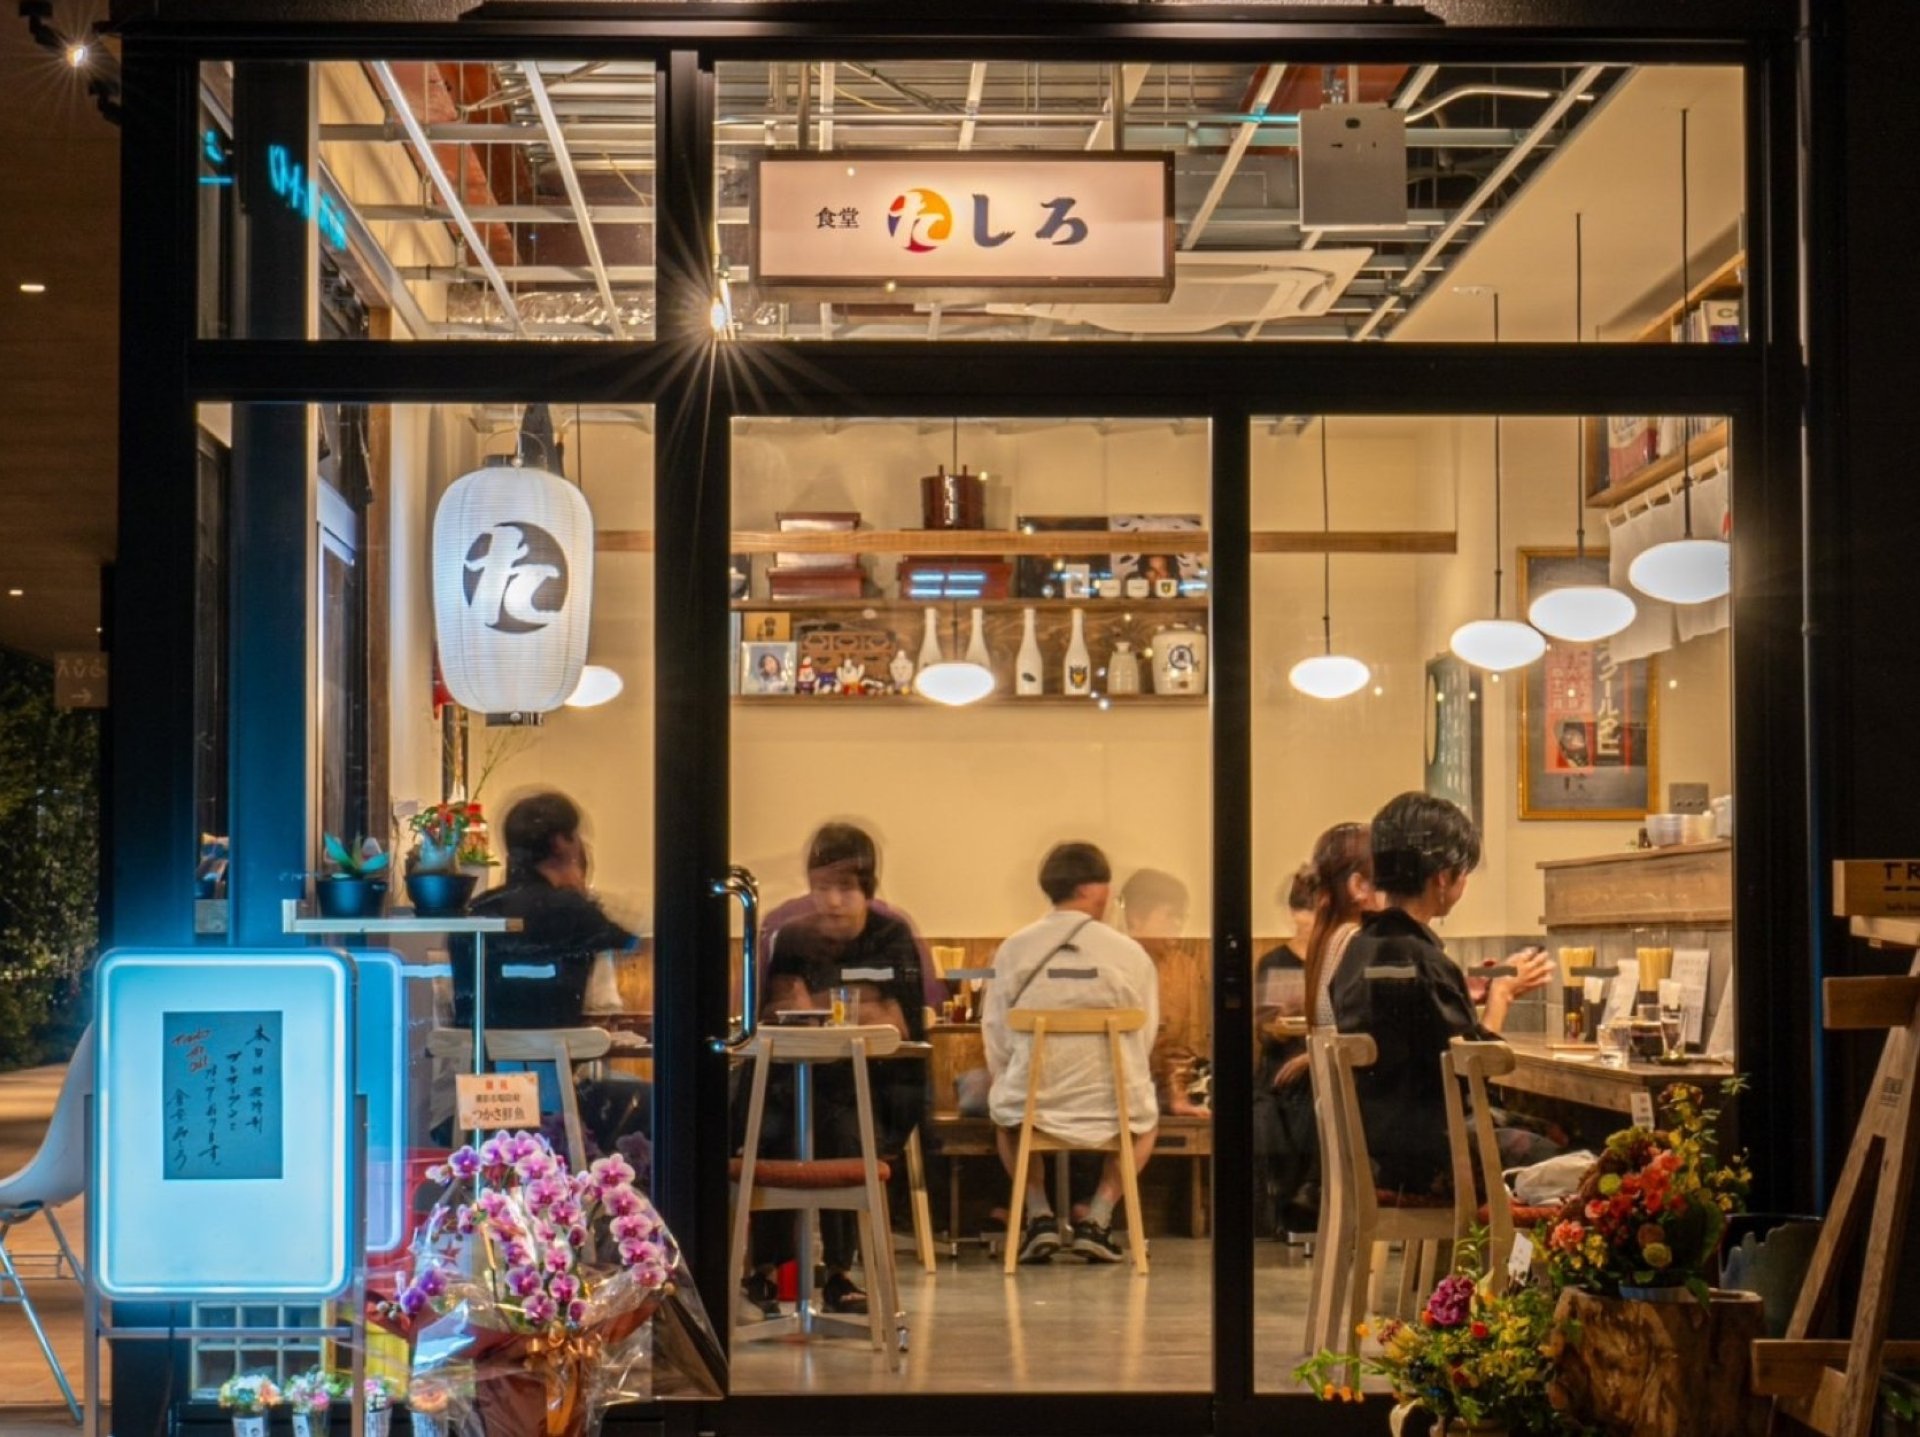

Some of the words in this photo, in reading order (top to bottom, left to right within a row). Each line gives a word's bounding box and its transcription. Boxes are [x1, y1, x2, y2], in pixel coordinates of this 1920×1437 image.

[815, 206, 860, 229] 食堂
[887, 188, 1089, 253] たしろ
[462, 521, 569, 634] た
